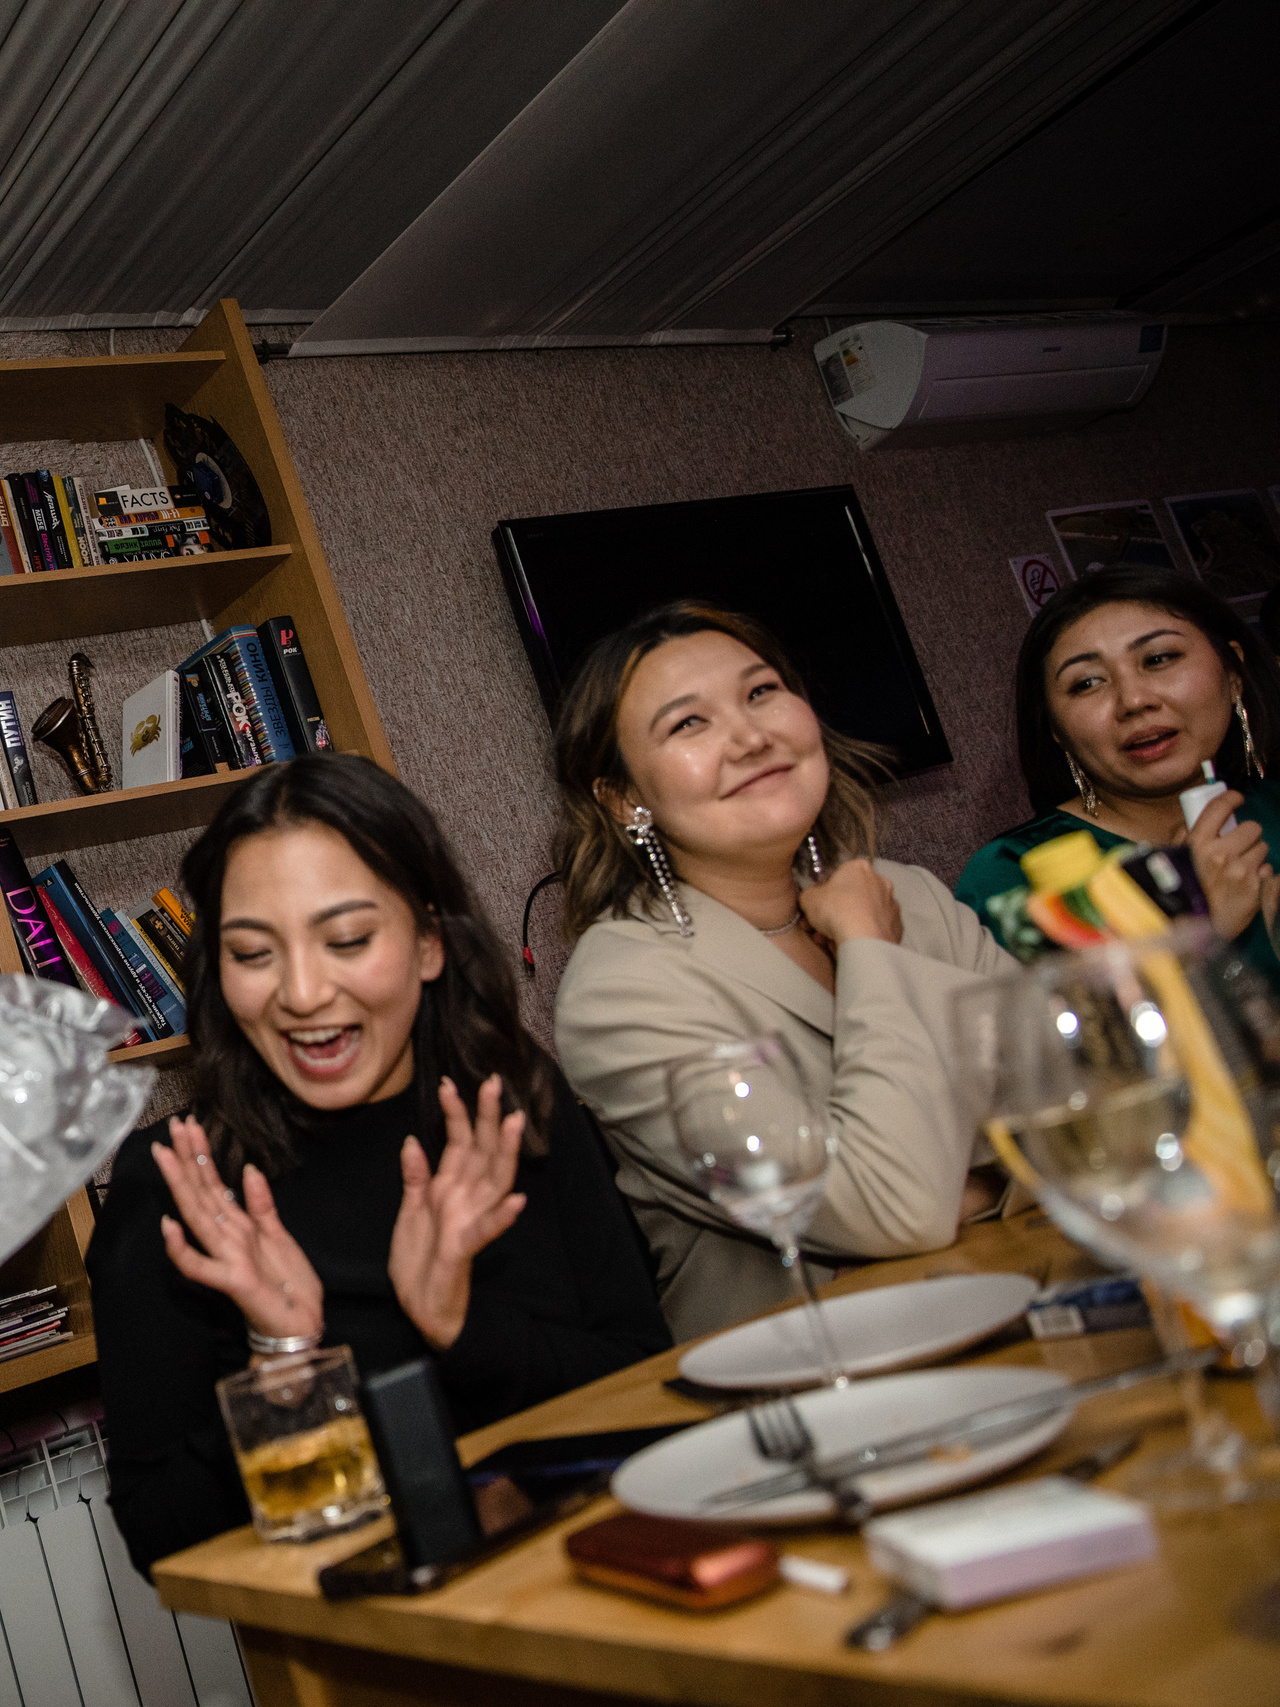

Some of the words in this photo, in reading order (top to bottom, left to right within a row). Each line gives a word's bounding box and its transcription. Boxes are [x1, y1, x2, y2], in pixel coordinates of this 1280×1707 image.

[121, 491, 169, 509] FACTS
[35, 509, 44, 531] MUSE
[41, 533, 53, 563] Electrify
[78, 536, 90, 564] MOON
[114, 540, 139, 550] ФРЭНК
[246, 642, 268, 683] КИНО
[283, 647, 298, 655] РОК
[263, 686, 284, 737] ЗВЕЗДЫ
[73, 881, 100, 920] удовольствия
[6, 886, 62, 969] DALI
[97, 918, 125, 959] марокканские
[122, 958, 138, 979] другие
[137, 982, 153, 1003] кус-кус
[149, 1001, 168, 1026] Таджин,
